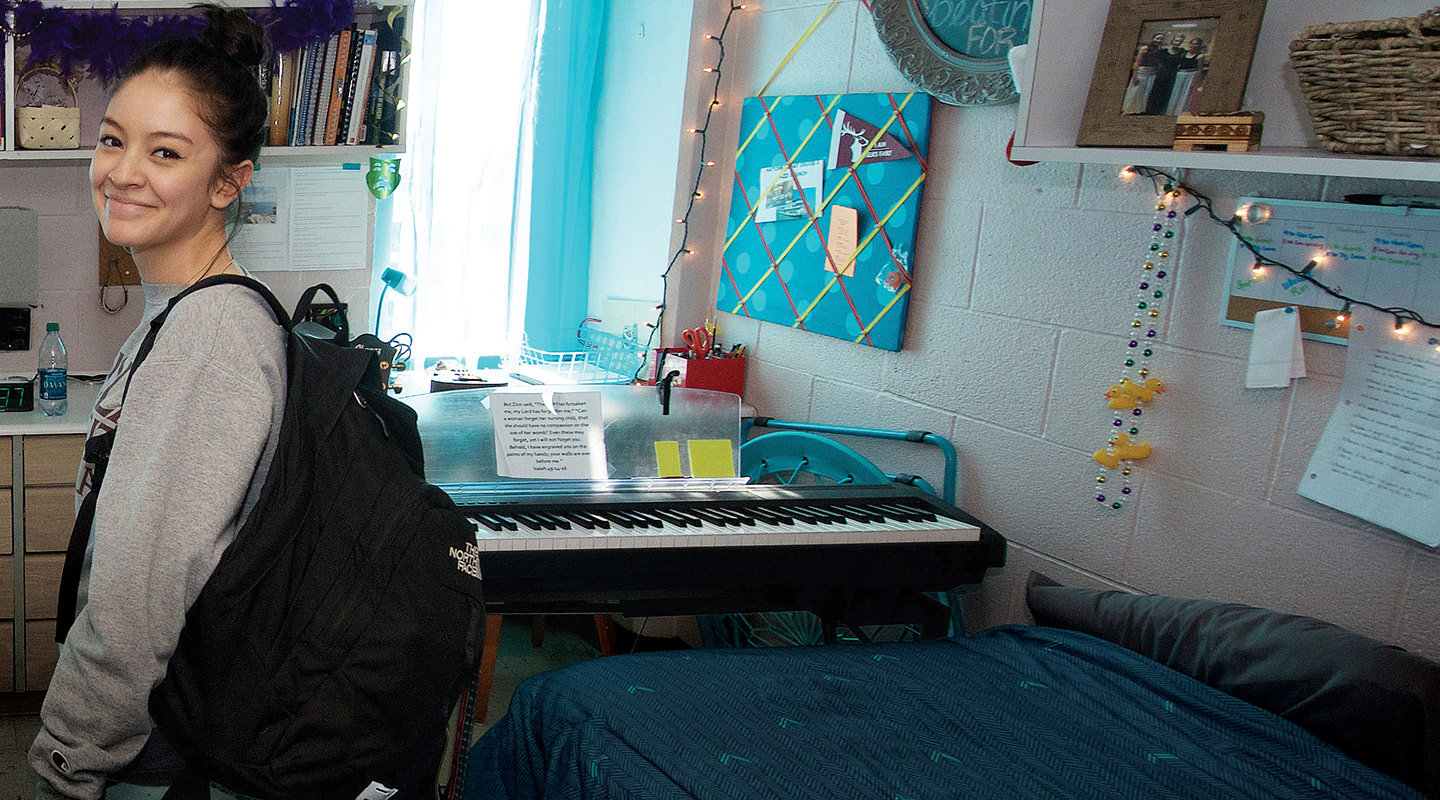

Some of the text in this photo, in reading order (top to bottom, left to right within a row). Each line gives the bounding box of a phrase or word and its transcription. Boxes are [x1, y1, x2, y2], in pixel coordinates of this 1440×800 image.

[927, 0, 1031, 31] beatin
[966, 22, 1017, 54] FOR
[449, 546, 479, 566] NORTH
[465, 542, 479, 558] THE
[458, 560, 478, 577] FACE
